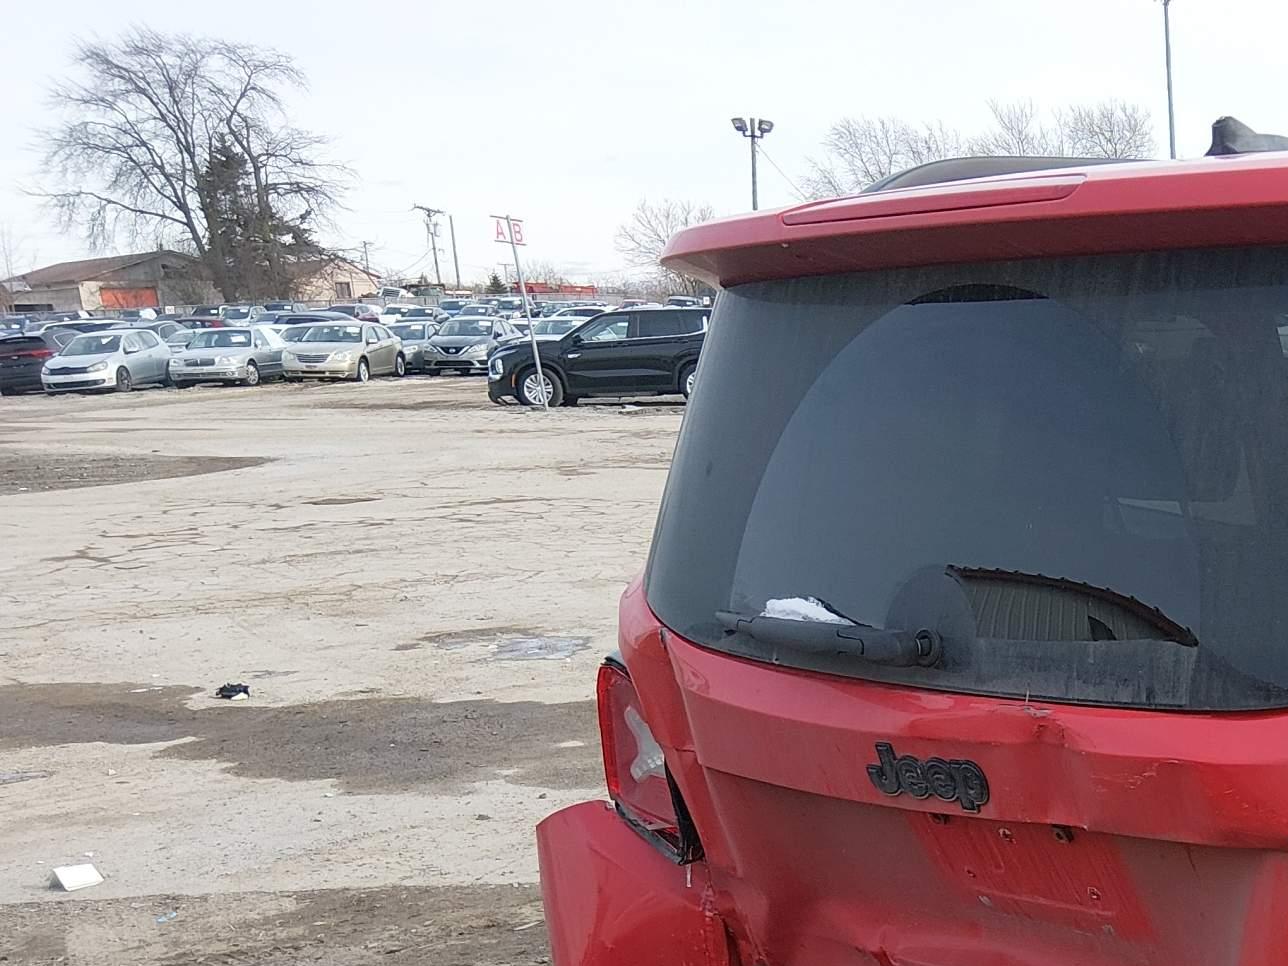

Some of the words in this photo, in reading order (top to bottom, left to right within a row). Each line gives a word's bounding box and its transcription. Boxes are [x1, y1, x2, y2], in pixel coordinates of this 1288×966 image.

[496, 219, 507, 241] A
[512, 222, 523, 243] B
[866, 742, 990, 814] Jeep
